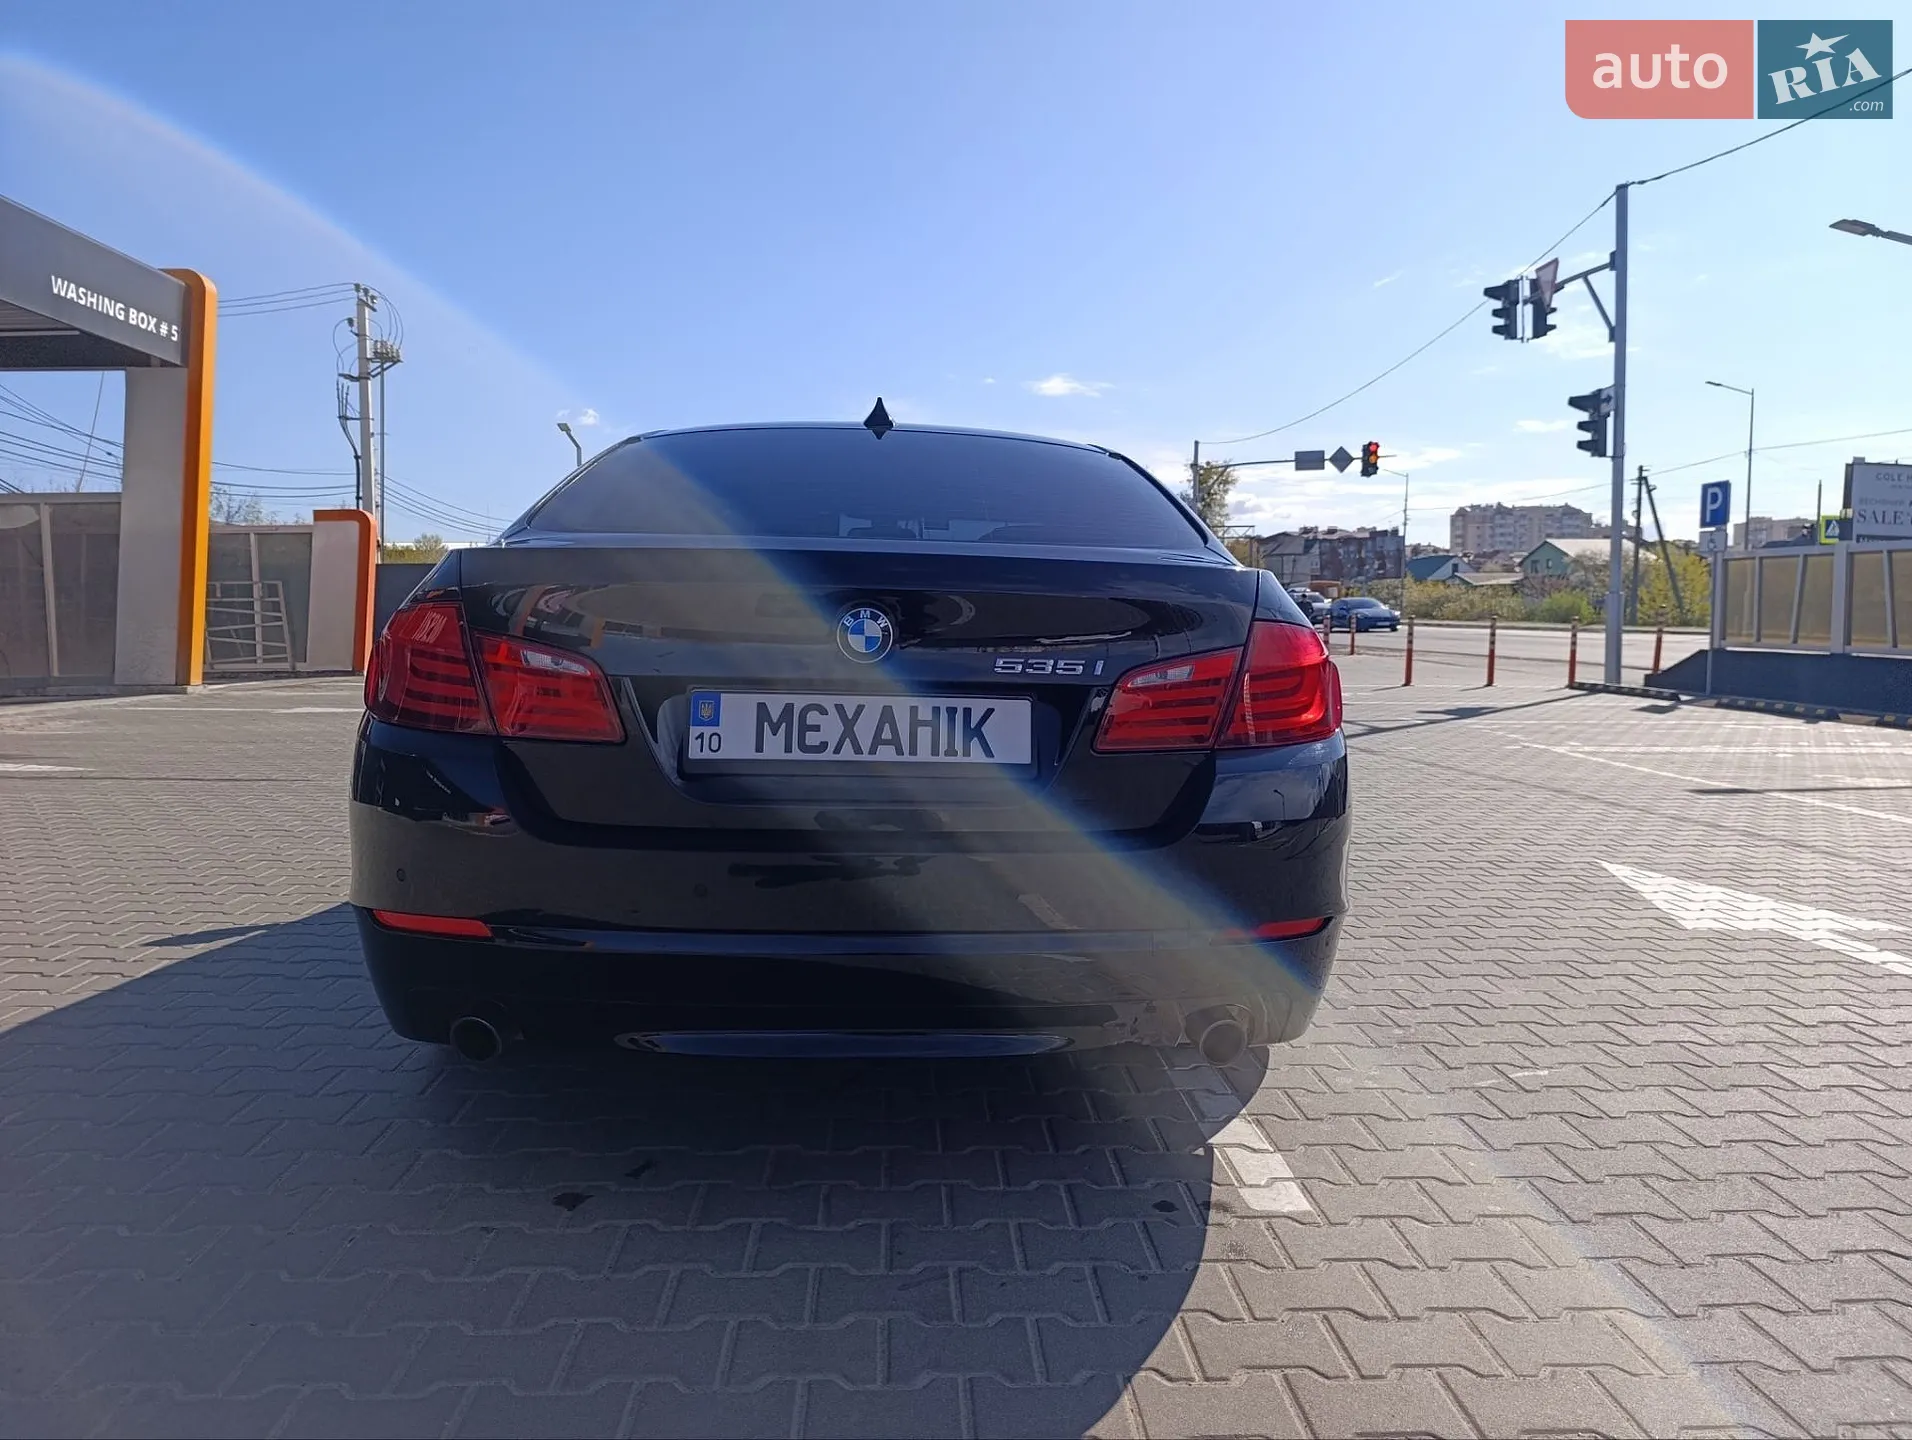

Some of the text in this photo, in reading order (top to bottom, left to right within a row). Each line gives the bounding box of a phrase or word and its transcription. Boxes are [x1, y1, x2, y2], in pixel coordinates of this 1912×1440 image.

[51, 275, 179, 342] WASHING BOX # 5
[1706, 486, 1723, 523] P
[843, 610, 889, 628] BMW
[694, 731, 722, 754] 10
